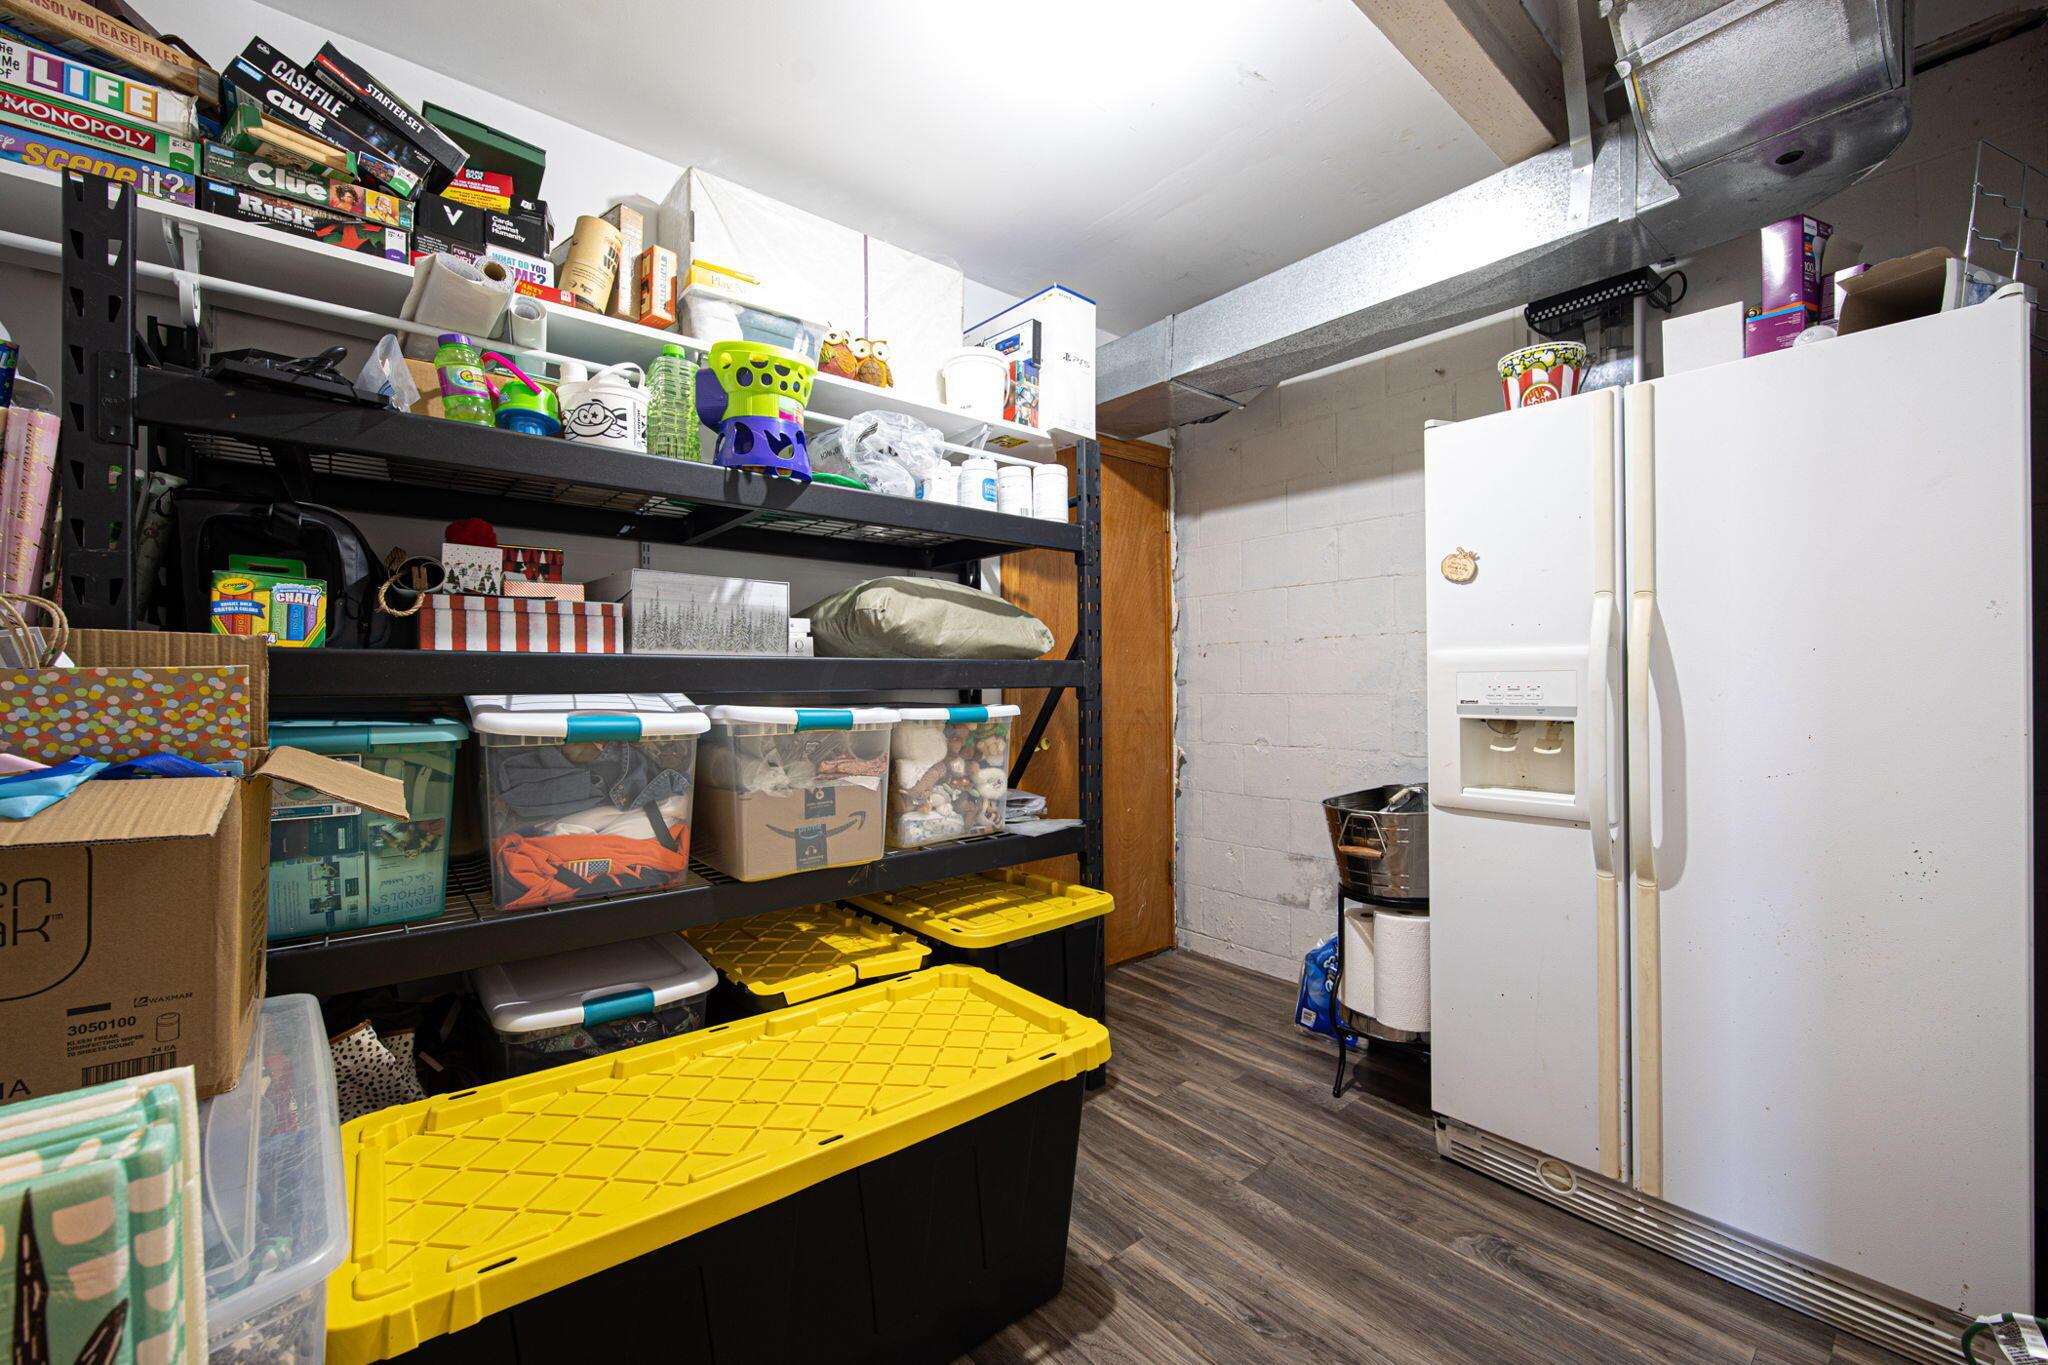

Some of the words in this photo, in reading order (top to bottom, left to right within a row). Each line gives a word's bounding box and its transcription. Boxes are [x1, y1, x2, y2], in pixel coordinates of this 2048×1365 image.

[29, 0, 94, 28] NSOLVED
[100, 22, 139, 49] CASE
[143, 43, 180, 66] FILES
[33, 56, 153, 118] LIFE
[271, 60, 348, 118] CASEFILE
[265, 89, 327, 131] CLUE
[365, 83, 408, 121] STARTER
[405, 116, 425, 134] SET
[5, 94, 151, 148] MONOPOLY
[141, 165, 185, 200] it?
[248, 162, 328, 201] Clue
[443, 204, 464, 226] V
[491, 215, 514, 227] Cards
[491, 222, 519, 235] Against
[491, 227, 526, 243] Humanity
[453, 247, 468, 255] FOR
[492, 251, 516, 268] WHAT
[517, 260, 530, 270] DO
[530, 263, 547, 275] YOU
[275, 592, 321, 607] CHALK
[372, 894, 437, 915] JENNIFER
[380, 885, 435, 905] ECHOLS
[149, 992, 194, 1004] WAXMAN
[66, 1016, 137, 1037] 3050100
[66, 1036, 93, 1047] KLEEN
[66, 1038, 121, 1052] DISINFECTING
[77, 1046, 107, 1057] SHEETS
[107, 1041, 136, 1051] COUNT
